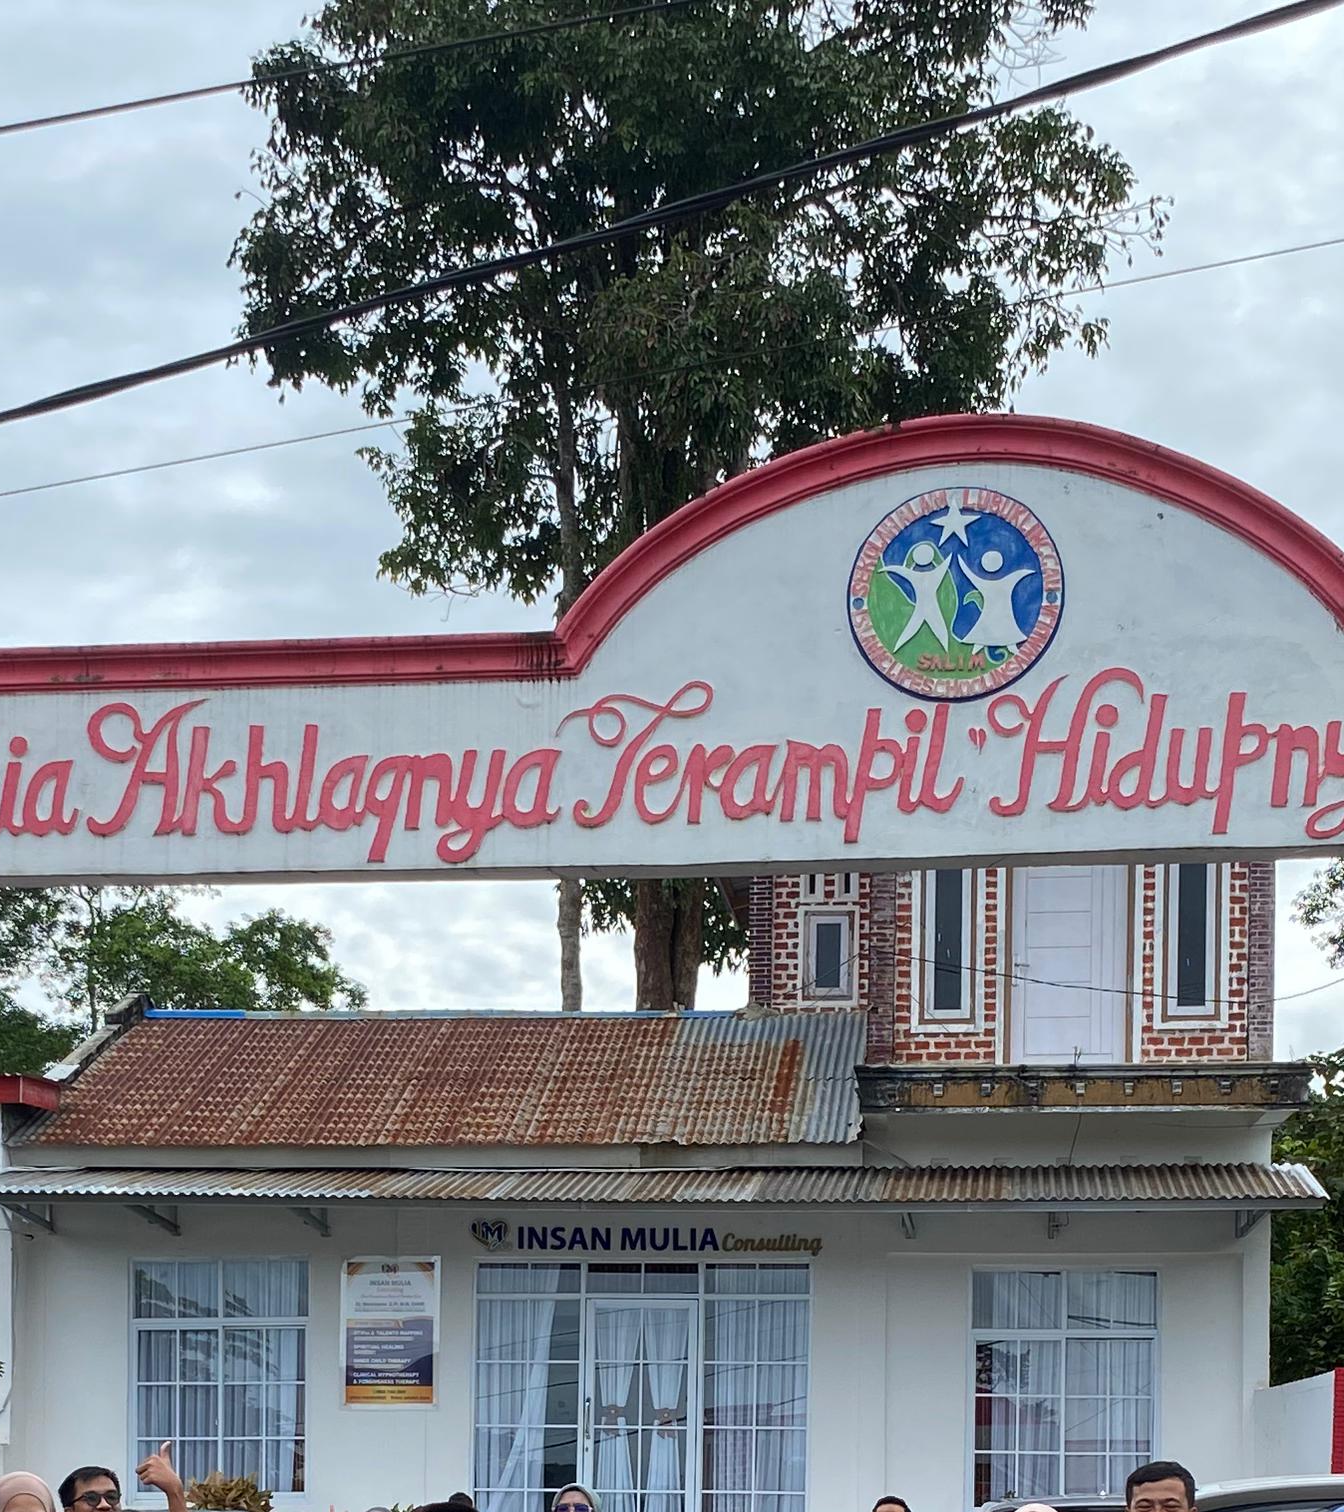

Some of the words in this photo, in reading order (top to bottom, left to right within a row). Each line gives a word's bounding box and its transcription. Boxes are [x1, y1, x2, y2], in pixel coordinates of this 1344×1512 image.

[917, 653, 986, 672] SALIM
[85, 699, 564, 864] Akhlaqnya
[517, 1226, 612, 1250] INSAN
[620, 1227, 720, 1251] MULIA
[722, 1233, 823, 1257] Consulting
